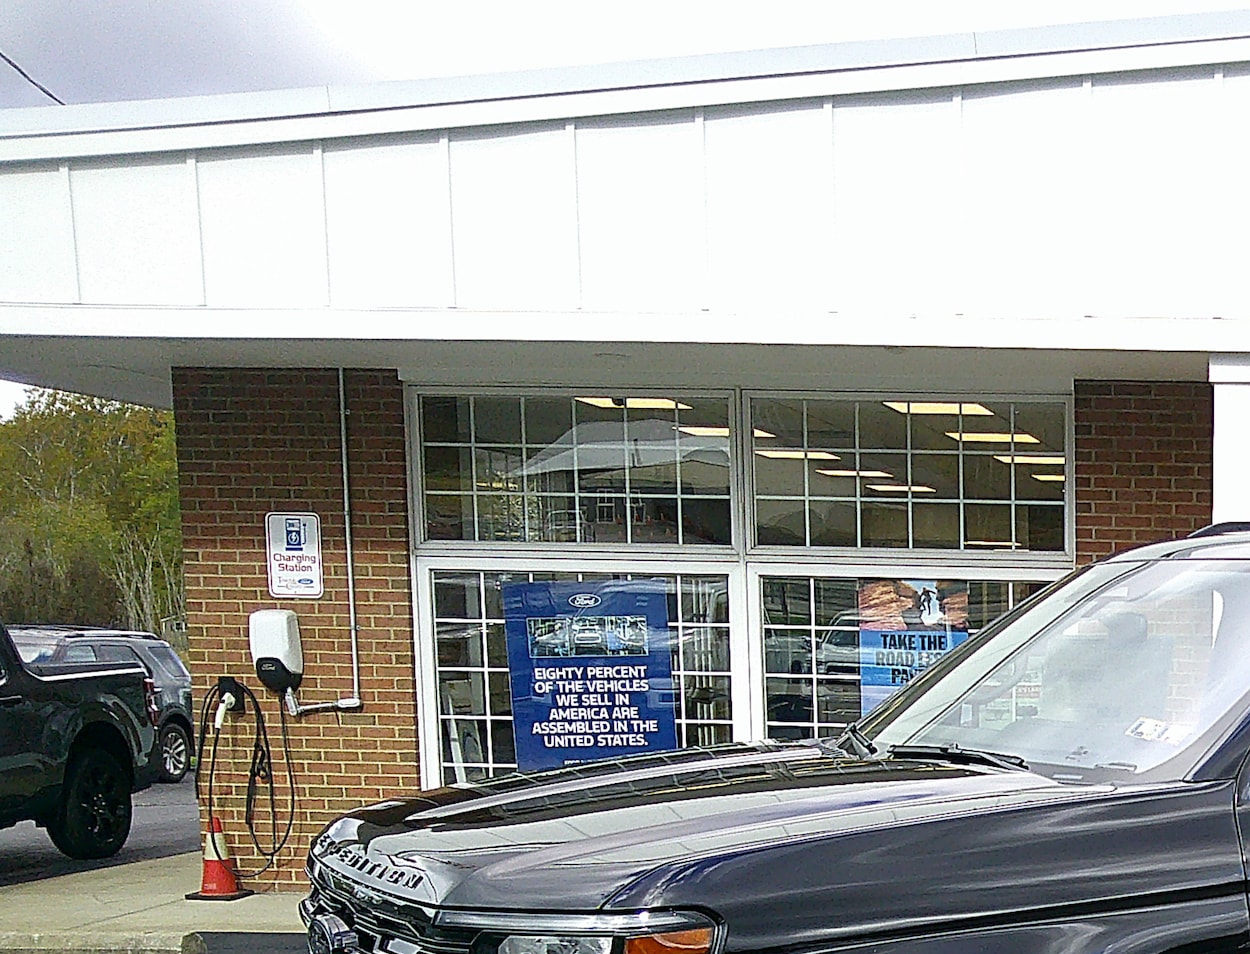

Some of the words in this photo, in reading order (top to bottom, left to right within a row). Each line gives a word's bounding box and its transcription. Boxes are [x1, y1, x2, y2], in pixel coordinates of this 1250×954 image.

[273, 553, 316, 564] Charging
[278, 563, 312, 572] Station
[881, 634, 916, 649] TAKE
[918, 635, 947, 650] THE
[876, 651, 914, 667] ROAD
[534, 667, 583, 680] EIGHTY
[587, 666, 647, 679] PERCENT
[534, 681, 554, 694] OF
[556, 681, 584, 693] THE
[584, 679, 649, 692] VEHICLES
[556, 694, 577, 706] WE
[582, 694, 612, 706] SELL
[615, 693, 629, 706] IN
[549, 708, 609, 720] AMERICA
[612, 707, 639, 719] ARE
[532, 721, 610, 734] ASSEMBLED
[614, 720, 628, 732] IN
[631, 720, 658, 732] THE
[544, 735, 594, 748] UNITED
[597, 734, 649, 747] STATES.
